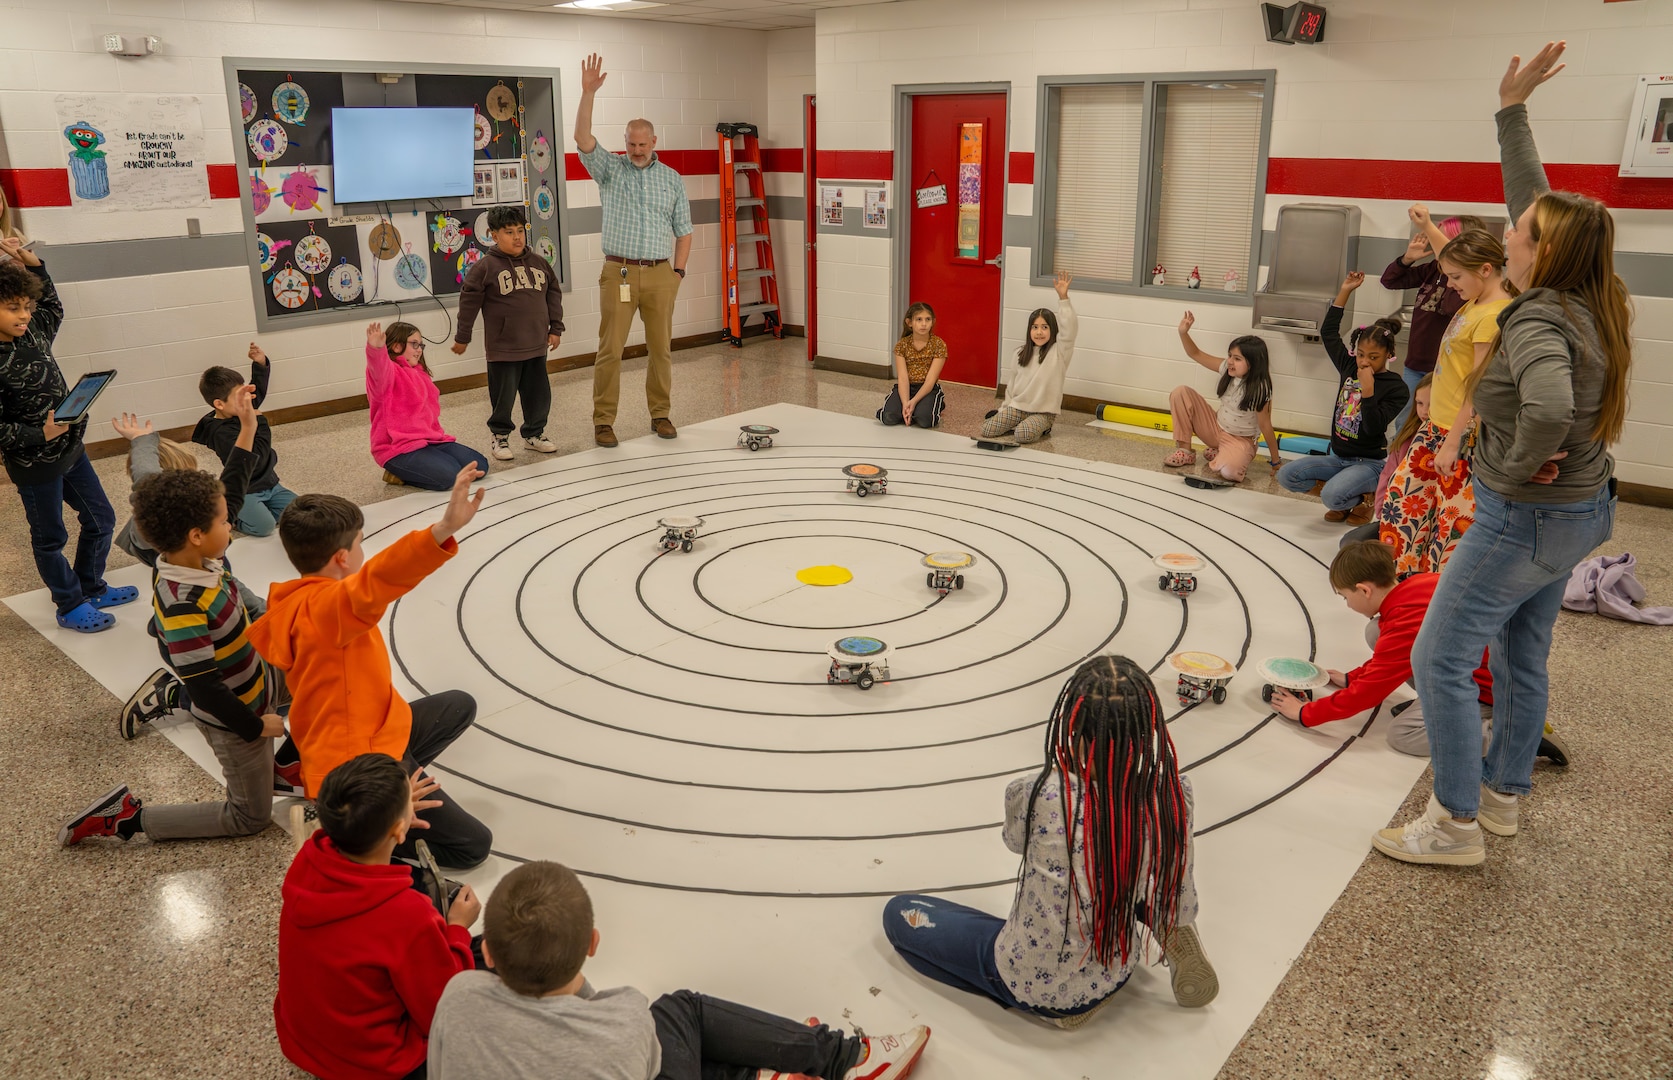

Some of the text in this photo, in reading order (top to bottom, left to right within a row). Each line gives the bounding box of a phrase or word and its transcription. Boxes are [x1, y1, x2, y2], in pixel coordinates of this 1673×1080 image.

[126, 132, 185, 140] 1st Grade can't be
[140, 141, 173, 150] GROUCHY
[138, 151, 176, 160] ABOUT OUR
[123, 160, 193, 169] AMAZING custodians!
[498, 265, 545, 296] GAP
